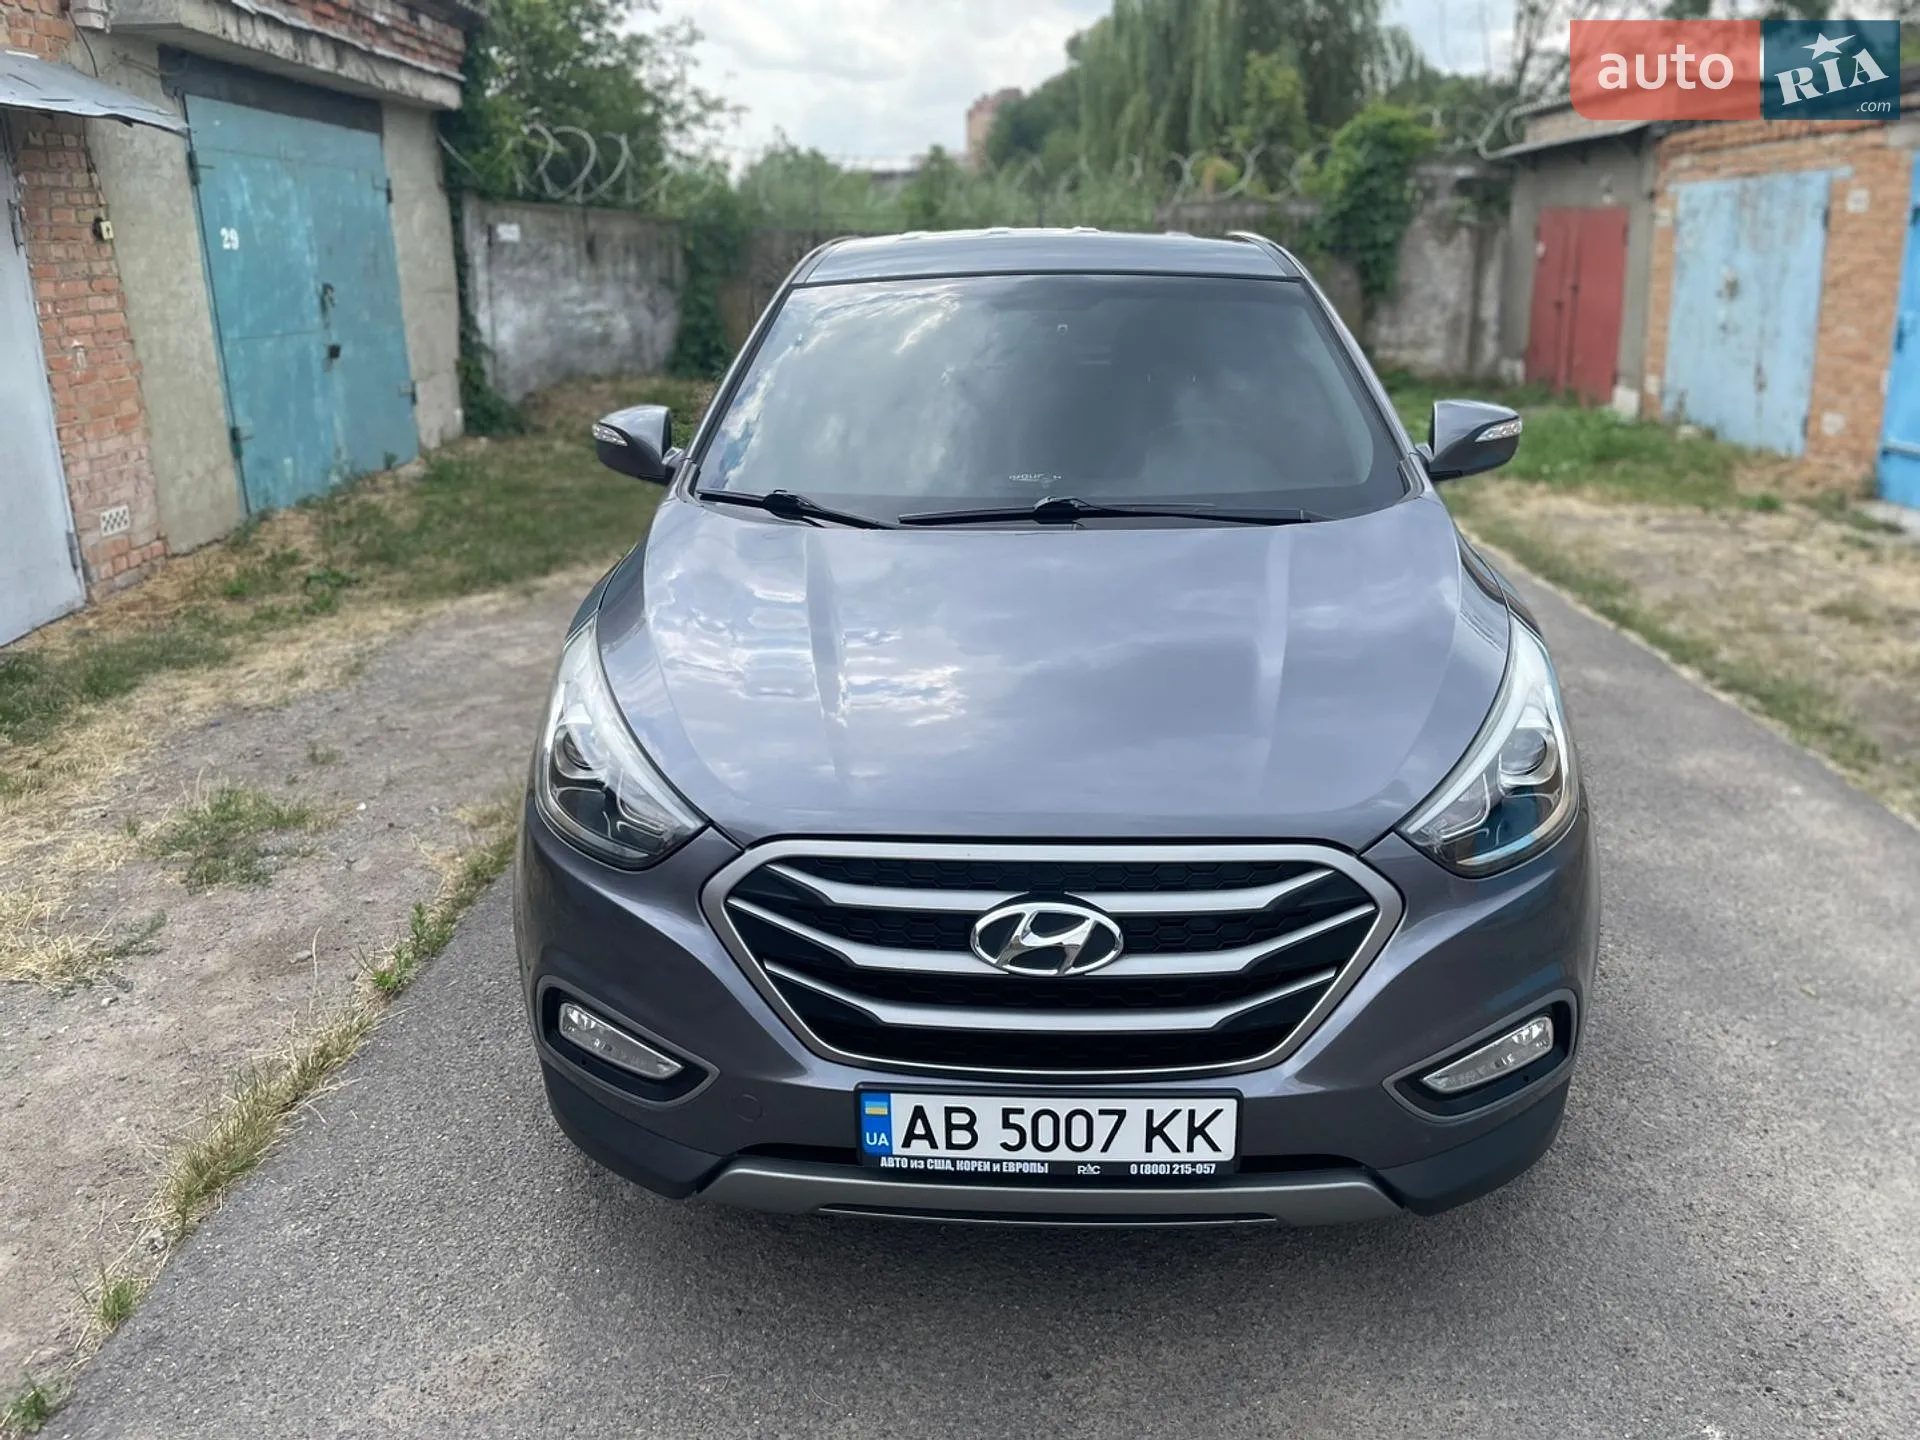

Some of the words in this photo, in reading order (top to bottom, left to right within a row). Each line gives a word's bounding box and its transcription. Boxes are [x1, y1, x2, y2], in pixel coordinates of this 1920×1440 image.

[901, 1104, 979, 1150] AB
[999, 1107, 1127, 1153] 5007
[1145, 1108, 1224, 1153] KK
[865, 1132, 889, 1147] UA
[880, 1156, 907, 1168] АВТО
[926, 1160, 954, 1171] США,
[1002, 1162, 1049, 1174] ЕВРОПЫ
[1130, 1164, 1137, 1175] 0
[1139, 1164, 1170, 1175] (800)
[1172, 1163, 1216, 1175] 215-057
